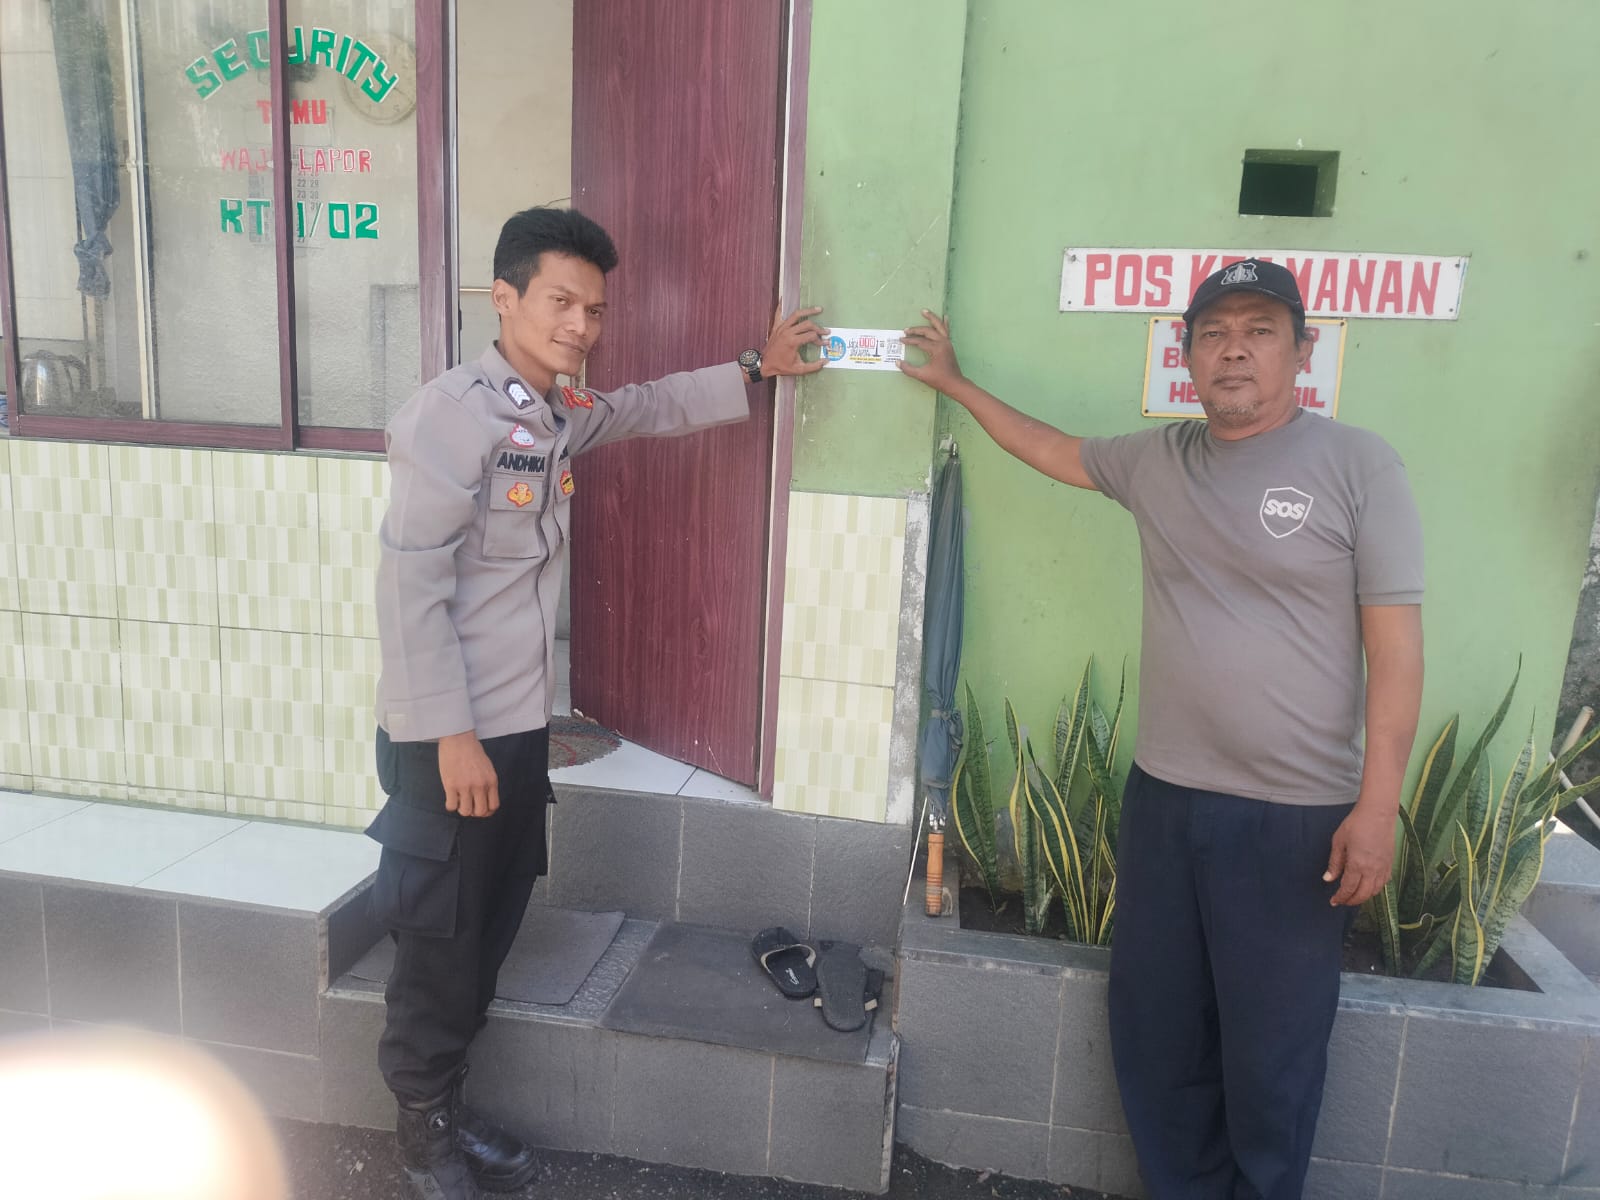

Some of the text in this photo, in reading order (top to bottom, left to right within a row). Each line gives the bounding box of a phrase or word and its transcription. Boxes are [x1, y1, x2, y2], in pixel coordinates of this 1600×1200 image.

[256, 99, 327, 125] TMU
[221, 148, 372, 173] WAJ LAPOR
[220, 198, 271, 236] RT
[1084, 253, 1441, 316] POS KMANAN
[496, 451, 546, 473] ANDHIKA
[1263, 498, 1306, 520] SOS
